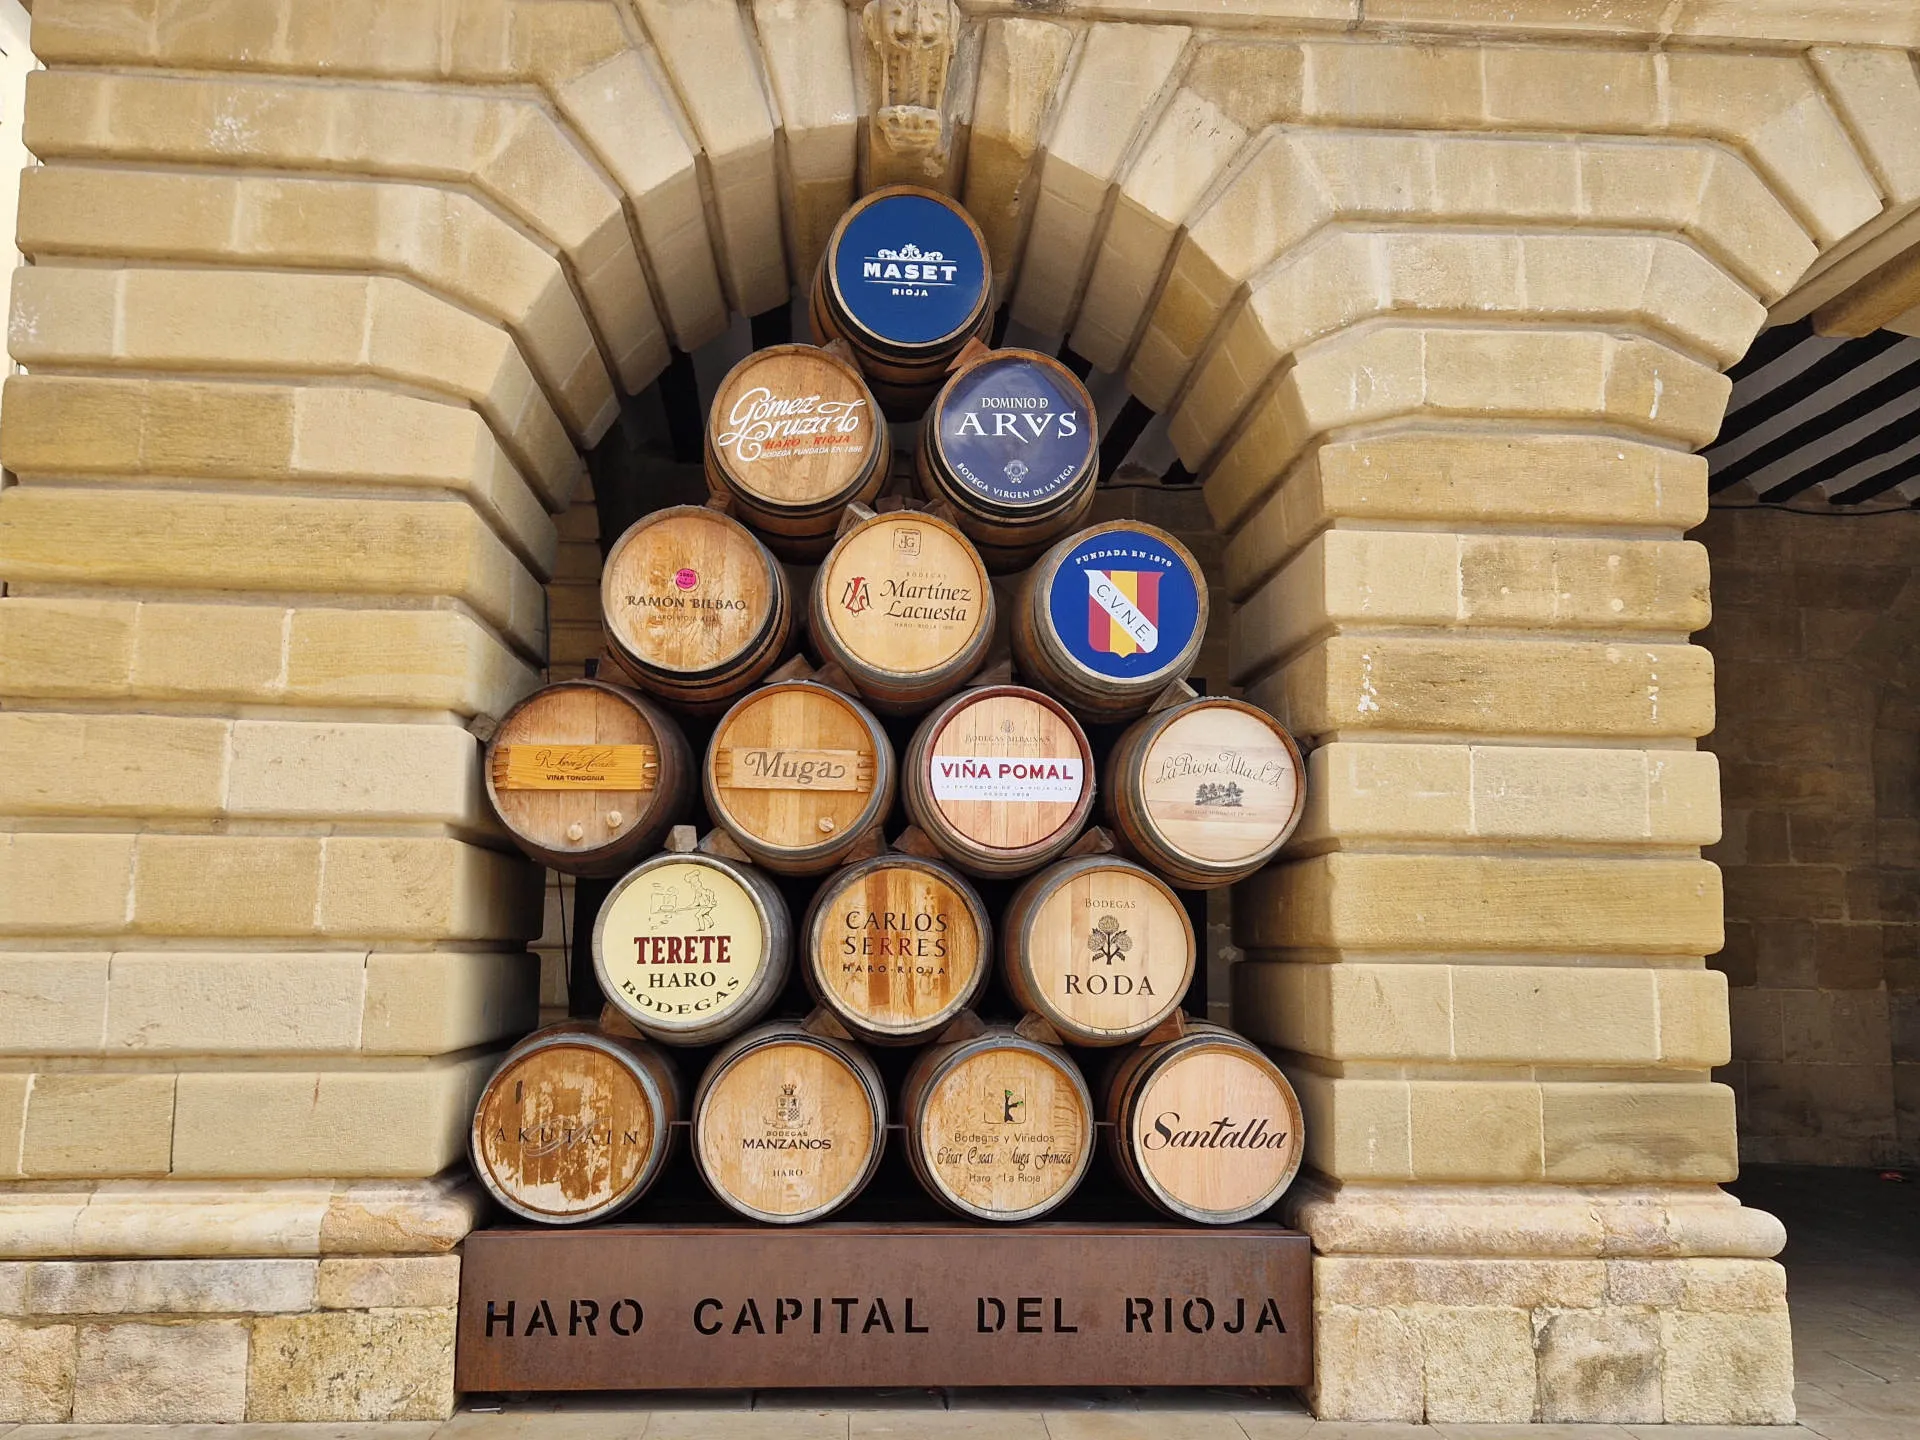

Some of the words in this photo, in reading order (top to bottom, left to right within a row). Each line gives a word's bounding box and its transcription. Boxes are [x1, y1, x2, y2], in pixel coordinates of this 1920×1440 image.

[863, 262, 958, 281] MASET
[892, 288, 929, 297] RIOJA
[981, 397, 1038, 409] DOMINIO
[717, 387, 821, 447] Gómez
[736, 399, 867, 462] Cruzado
[764, 438, 801, 450] HARO
[813, 435, 851, 446] RIOJA
[956, 462, 989, 492] BODEGA
[993, 487, 1030, 499] VIRGEN
[1033, 487, 1044, 497] DE
[1045, 482, 1055, 493] LA
[1055, 464, 1076, 486] VEGA
[1075, 549, 1128, 565] FUNDADA
[1132, 550, 1147, 559] EN
[1149, 554, 1173, 567] 1879
[879, 578, 972, 602] Martínez
[689, 599, 746, 611] BILBAO
[884, 600, 967, 621] Lacuesta
[744, 751, 846, 785] Muga
[940, 759, 992, 779] VIÑA
[998, 763, 1074, 780] POMAL
[1154, 757, 1177, 784] La
[1175, 752, 1218, 776] Rioja
[1085, 898, 1136, 909] BODEGAS
[846, 911, 948, 932] CARLOS
[634, 935, 731, 965] TERETE
[843, 936, 948, 958] SERRES
[842, 963, 887, 974] HARO
[897, 965, 945, 974] RIOJA
[649, 971, 716, 988] HARO
[1064, 974, 1156, 996] RODA
[620, 976, 740, 1015] BODEGAS
[494, 1127, 638, 1146] AKUTAIN
[954, 1133, 999, 1144] Bodegas
[1004, 1135, 1010, 1143] y
[1143, 1111, 1288, 1150] Santalba
[742, 1139, 832, 1150] MANZANOS
[772, 1169, 804, 1177] HARO
[969, 1173, 991, 1183] Haro
[1017, 1173, 1041, 1184] Rioja
[485, 1299, 644, 1337] HARO
[693, 1297, 930, 1336] CAPITAL
[976, 1297, 1079, 1334] DEL
[1125, 1297, 1288, 1335] RIOJA
